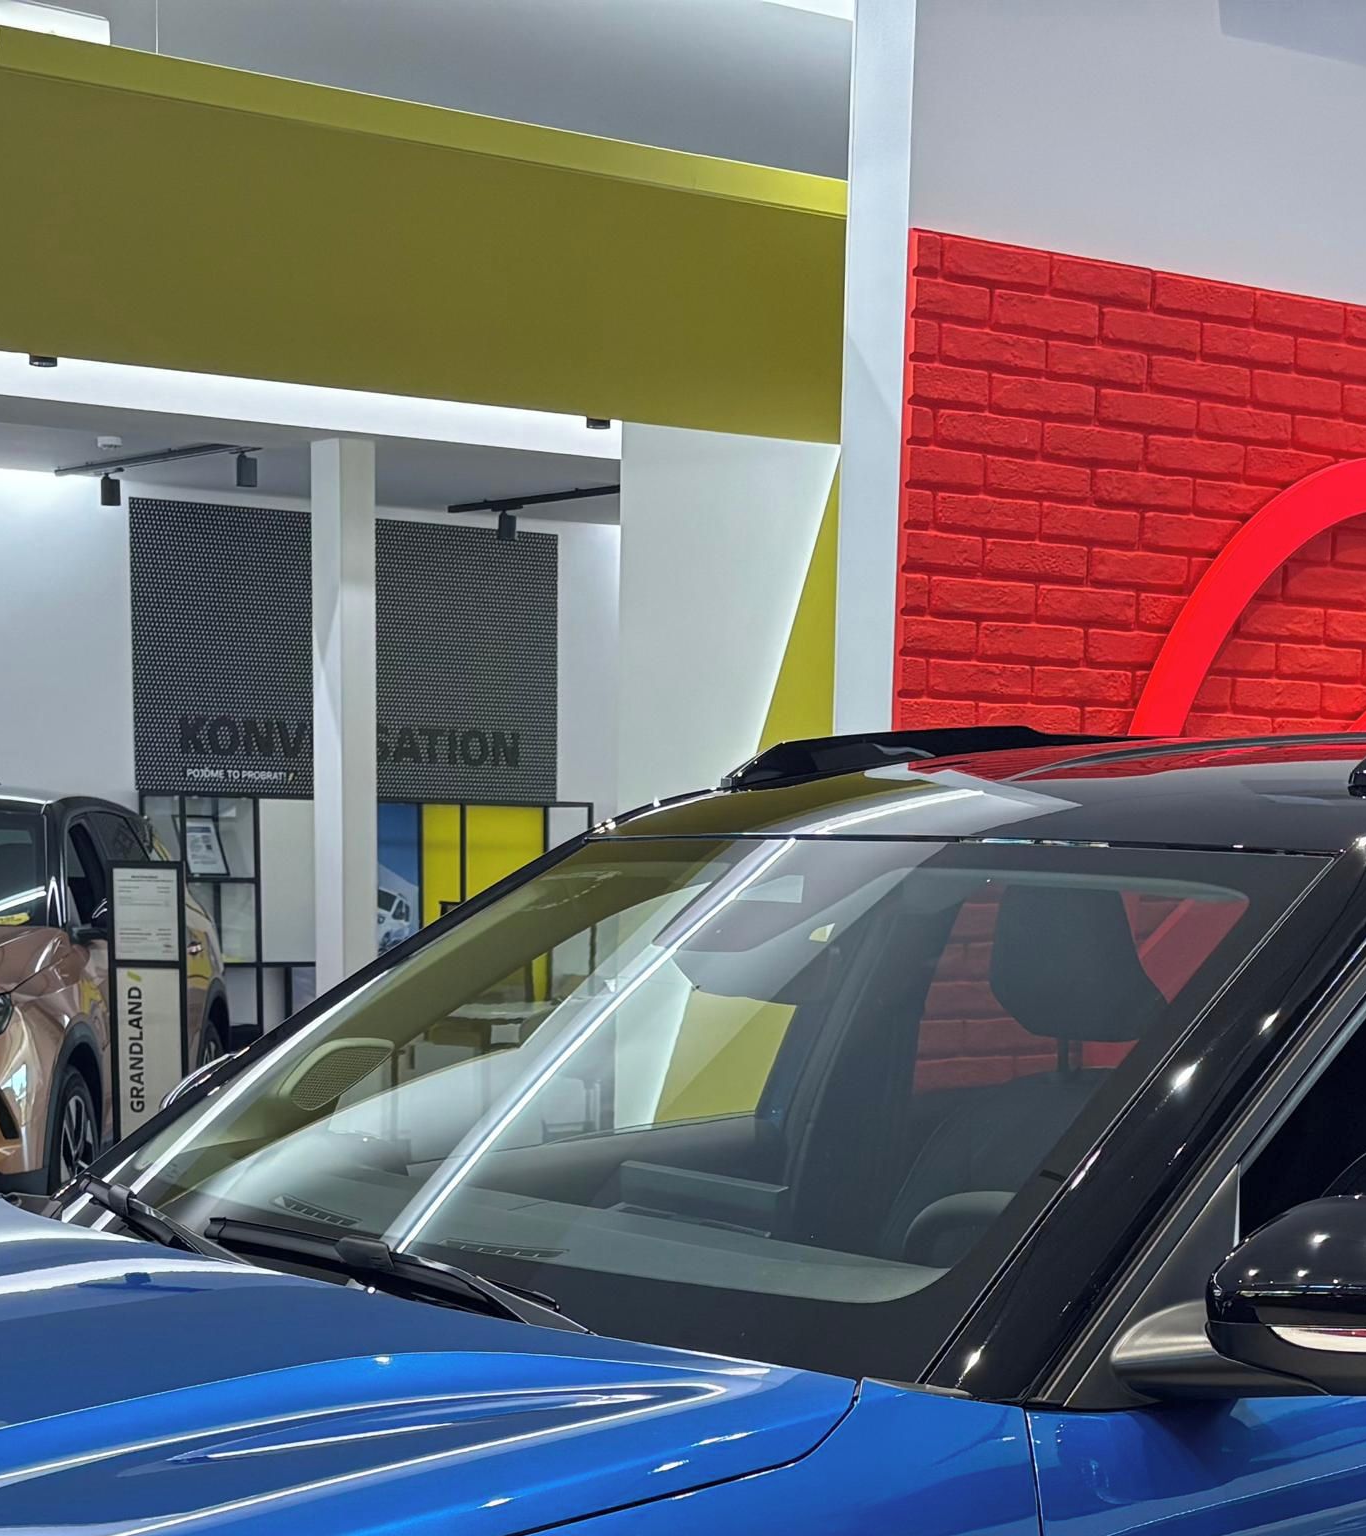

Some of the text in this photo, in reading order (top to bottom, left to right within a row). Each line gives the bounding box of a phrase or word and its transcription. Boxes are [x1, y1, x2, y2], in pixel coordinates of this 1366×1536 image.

[178, 714, 521, 768] KONVSATION
[227, 769, 240, 780] TO
[128, 986, 145, 1113] GRANDLAND
